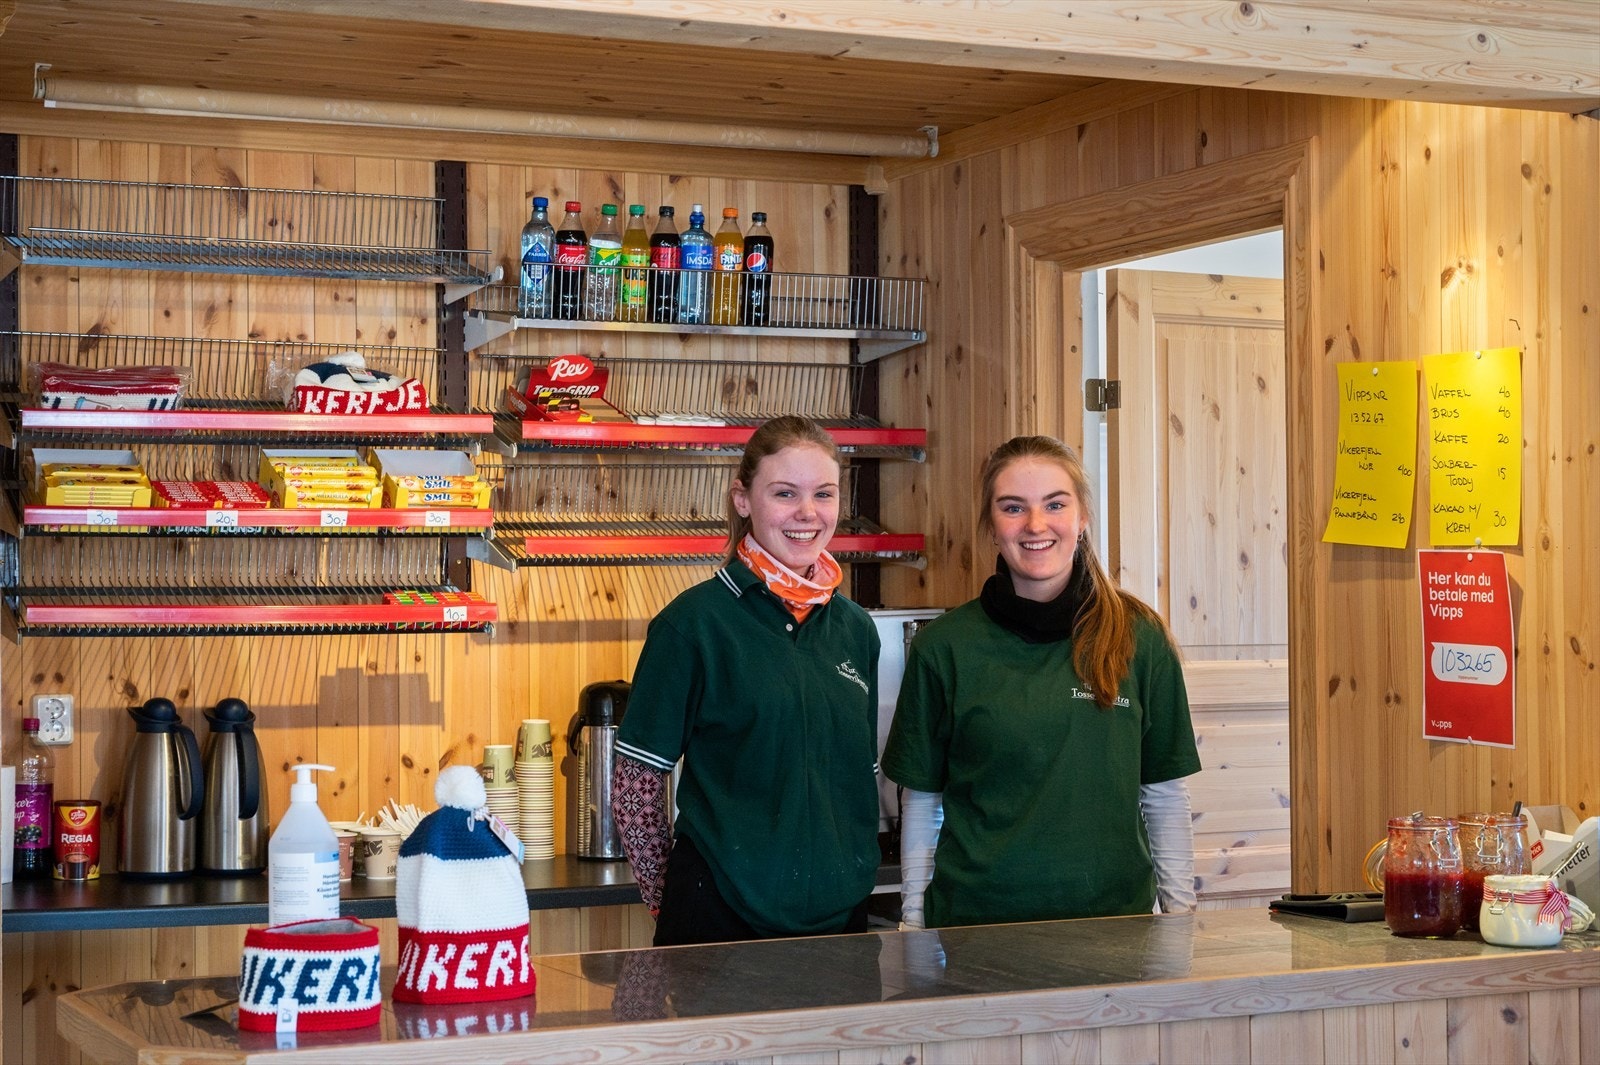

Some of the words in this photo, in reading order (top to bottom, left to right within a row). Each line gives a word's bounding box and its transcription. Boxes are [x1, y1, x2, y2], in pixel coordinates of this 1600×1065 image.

[686, 255, 712, 265] IMSDA
[550, 358, 588, 381] Rex
[533, 384, 600, 396] TapeGRIP
[1431, 382, 1471, 400] VAFFEL
[1499, 385, 1511, 398] 40
[1430, 407, 1460, 420] BRUS
[1498, 405, 1511, 419] 40
[1434, 429, 1469, 444] KAFFE
[1497, 433, 1510, 444] 20
[1397, 464, 1412, 477] 400
[1497, 467, 1507, 480] 15
[424, 480, 453, 489] SMIL
[1445, 474, 1474, 493] TODDY
[424, 493, 452, 501] SMIL
[1433, 502, 1465, 514] KAKAO
[1493, 510, 1507, 528] 30
[1446, 522, 1471, 534] KREM
[1428, 571, 1452, 585] Her
[1454, 572, 1476, 586] kan
[1477, 573, 1491, 586] du
[1429, 588, 1468, 602] betale
[1470, 590, 1495, 603] med
[1430, 604, 1464, 620] Vipps
[1441, 646, 1496, 673] 103265
[61, 833, 93, 844] REGIA
